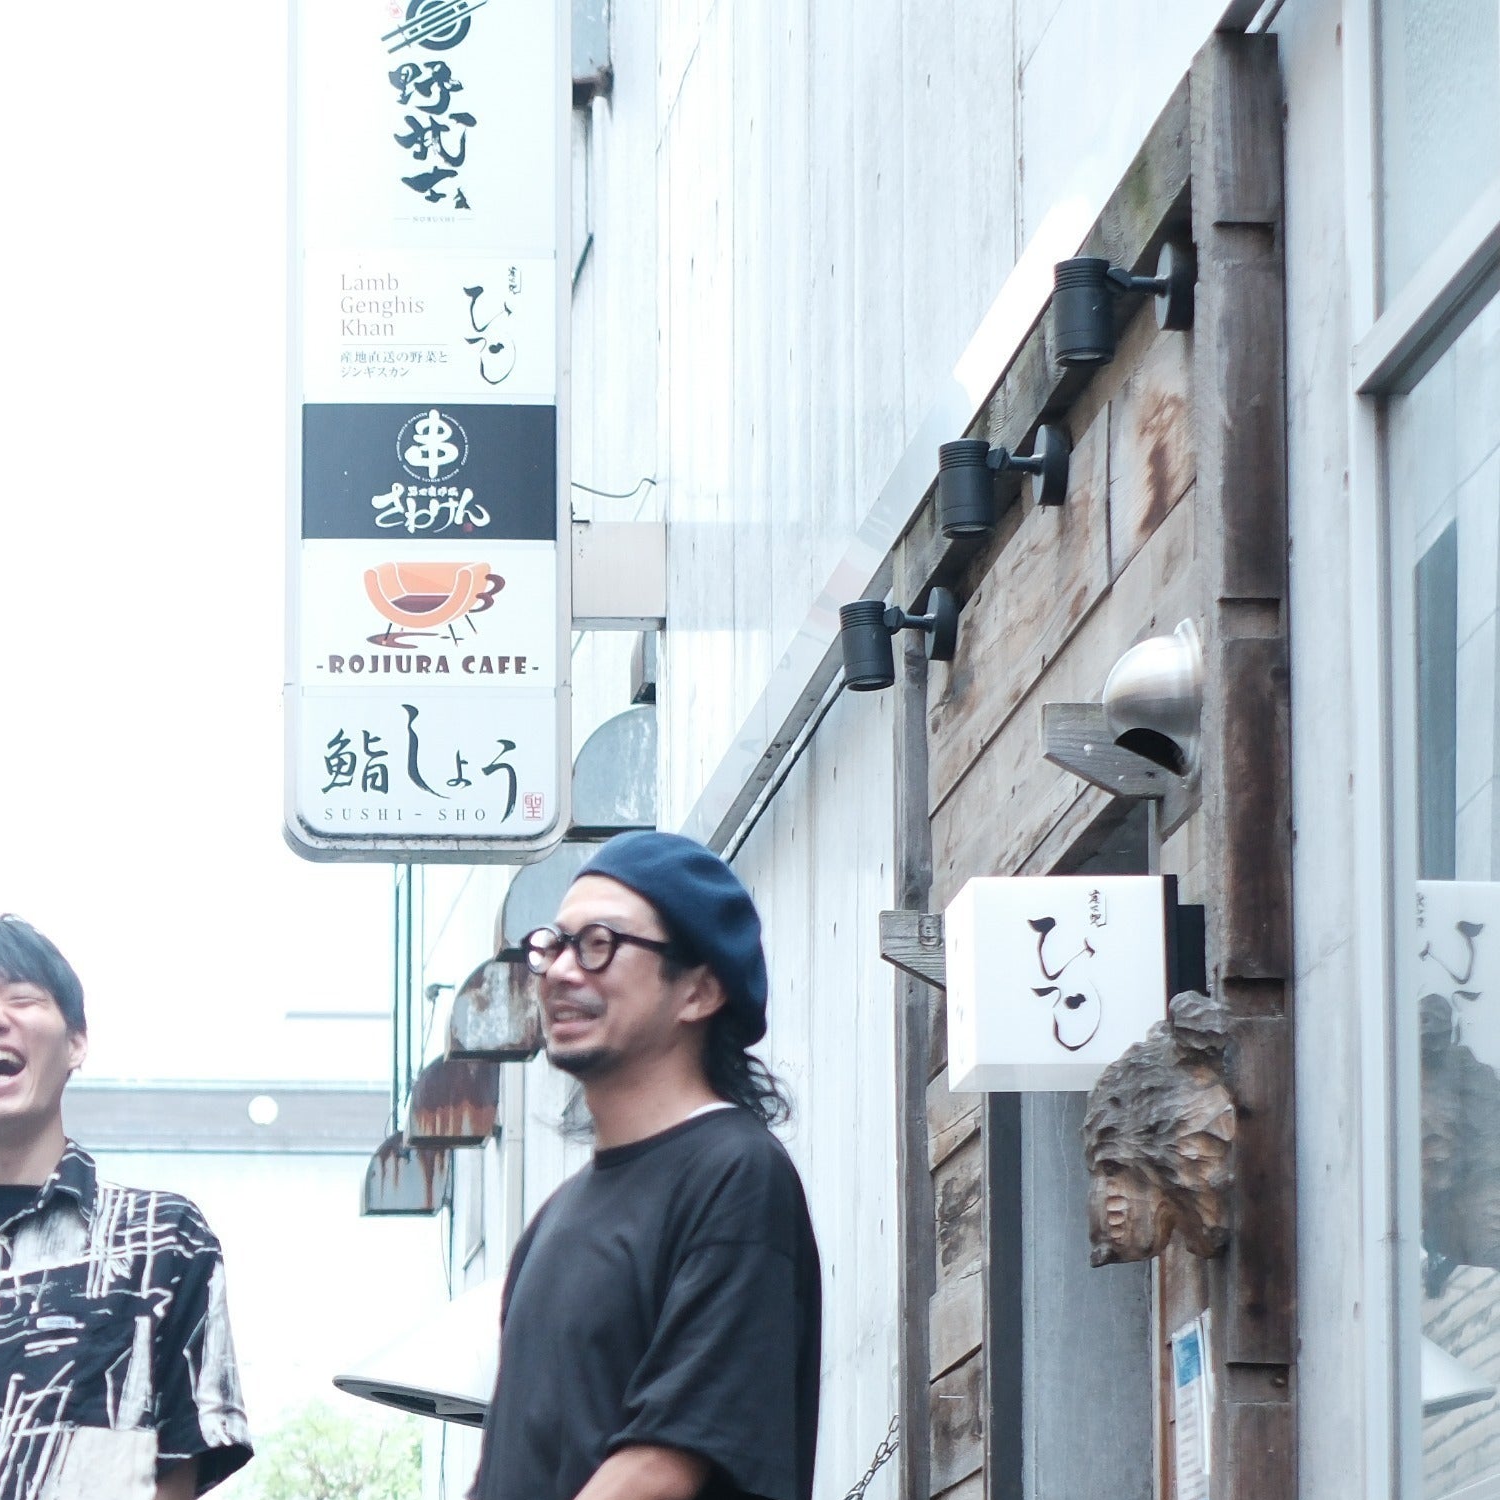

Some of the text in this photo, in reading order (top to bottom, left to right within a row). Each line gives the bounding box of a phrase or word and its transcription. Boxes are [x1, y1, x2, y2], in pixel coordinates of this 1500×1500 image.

[388, 60, 477, 210] 野武士
[340, 273, 399, 291] Lamb
[340, 296, 425, 318] Genghis
[340, 319, 396, 337] Khan
[340, 350, 449, 364] 産地直送の野菜と
[340, 366, 411, 379] ジンギスカン
[404, 409, 459, 479] 串
[371, 483, 491, 534] さわけん
[321, 704, 518, 825] 鮨しょう
